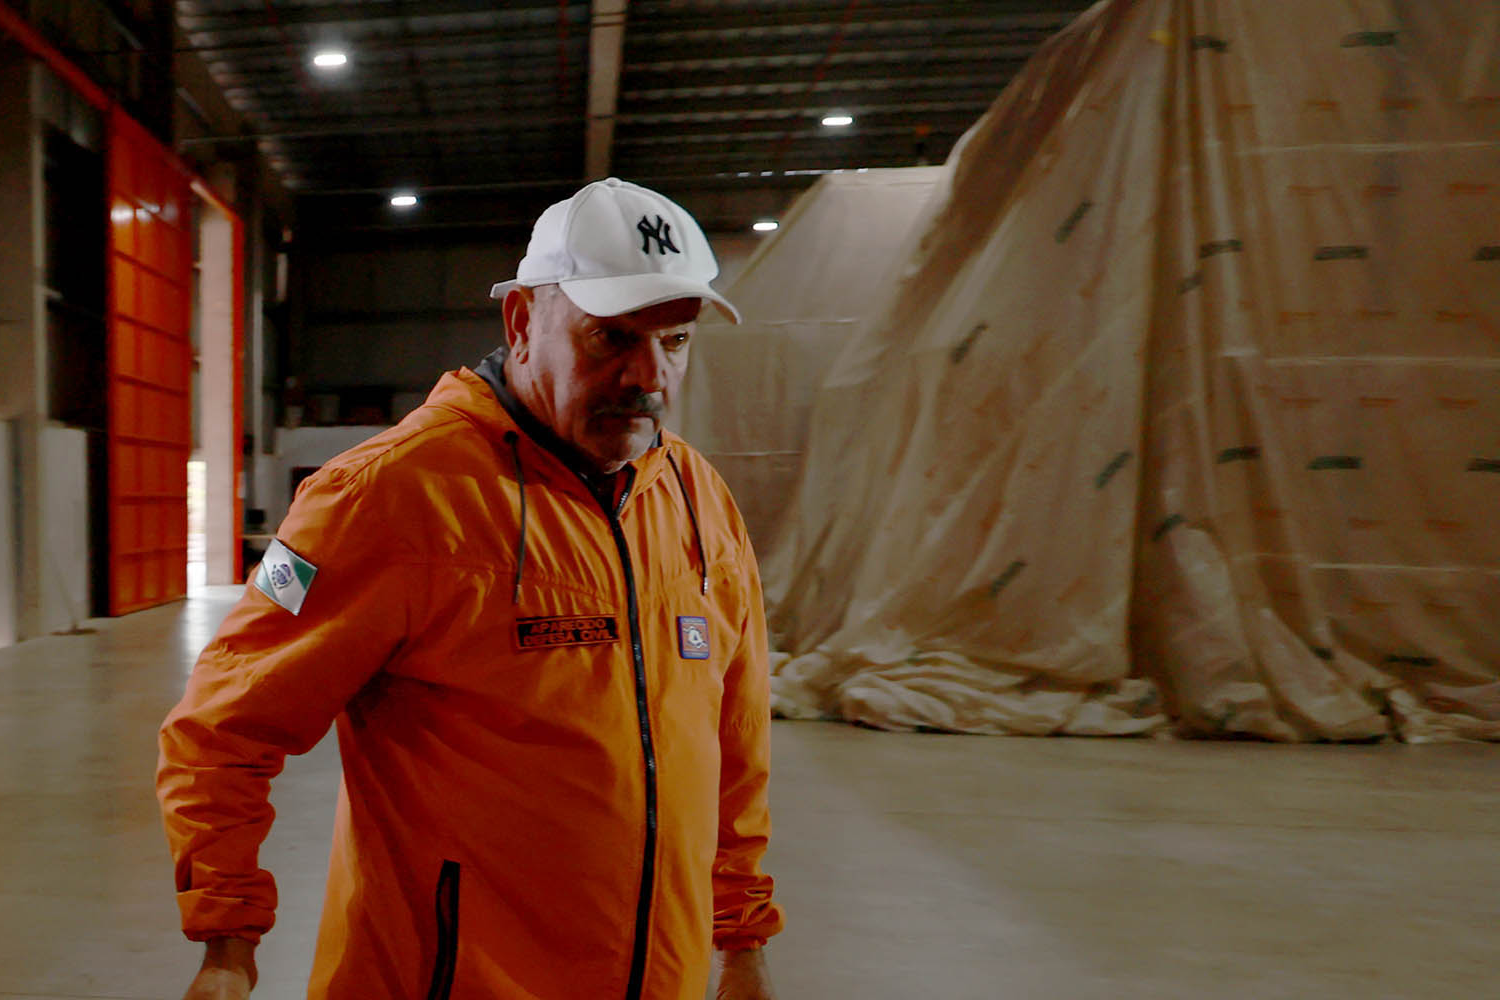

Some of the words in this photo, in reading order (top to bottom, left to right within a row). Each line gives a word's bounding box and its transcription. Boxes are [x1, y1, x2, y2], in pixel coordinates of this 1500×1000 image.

[637, 215, 681, 255] NY
[531, 619, 606, 634] APARECIDO
[524, 632, 575, 645] DEFESA
[581, 629, 613, 642] CIVIL
